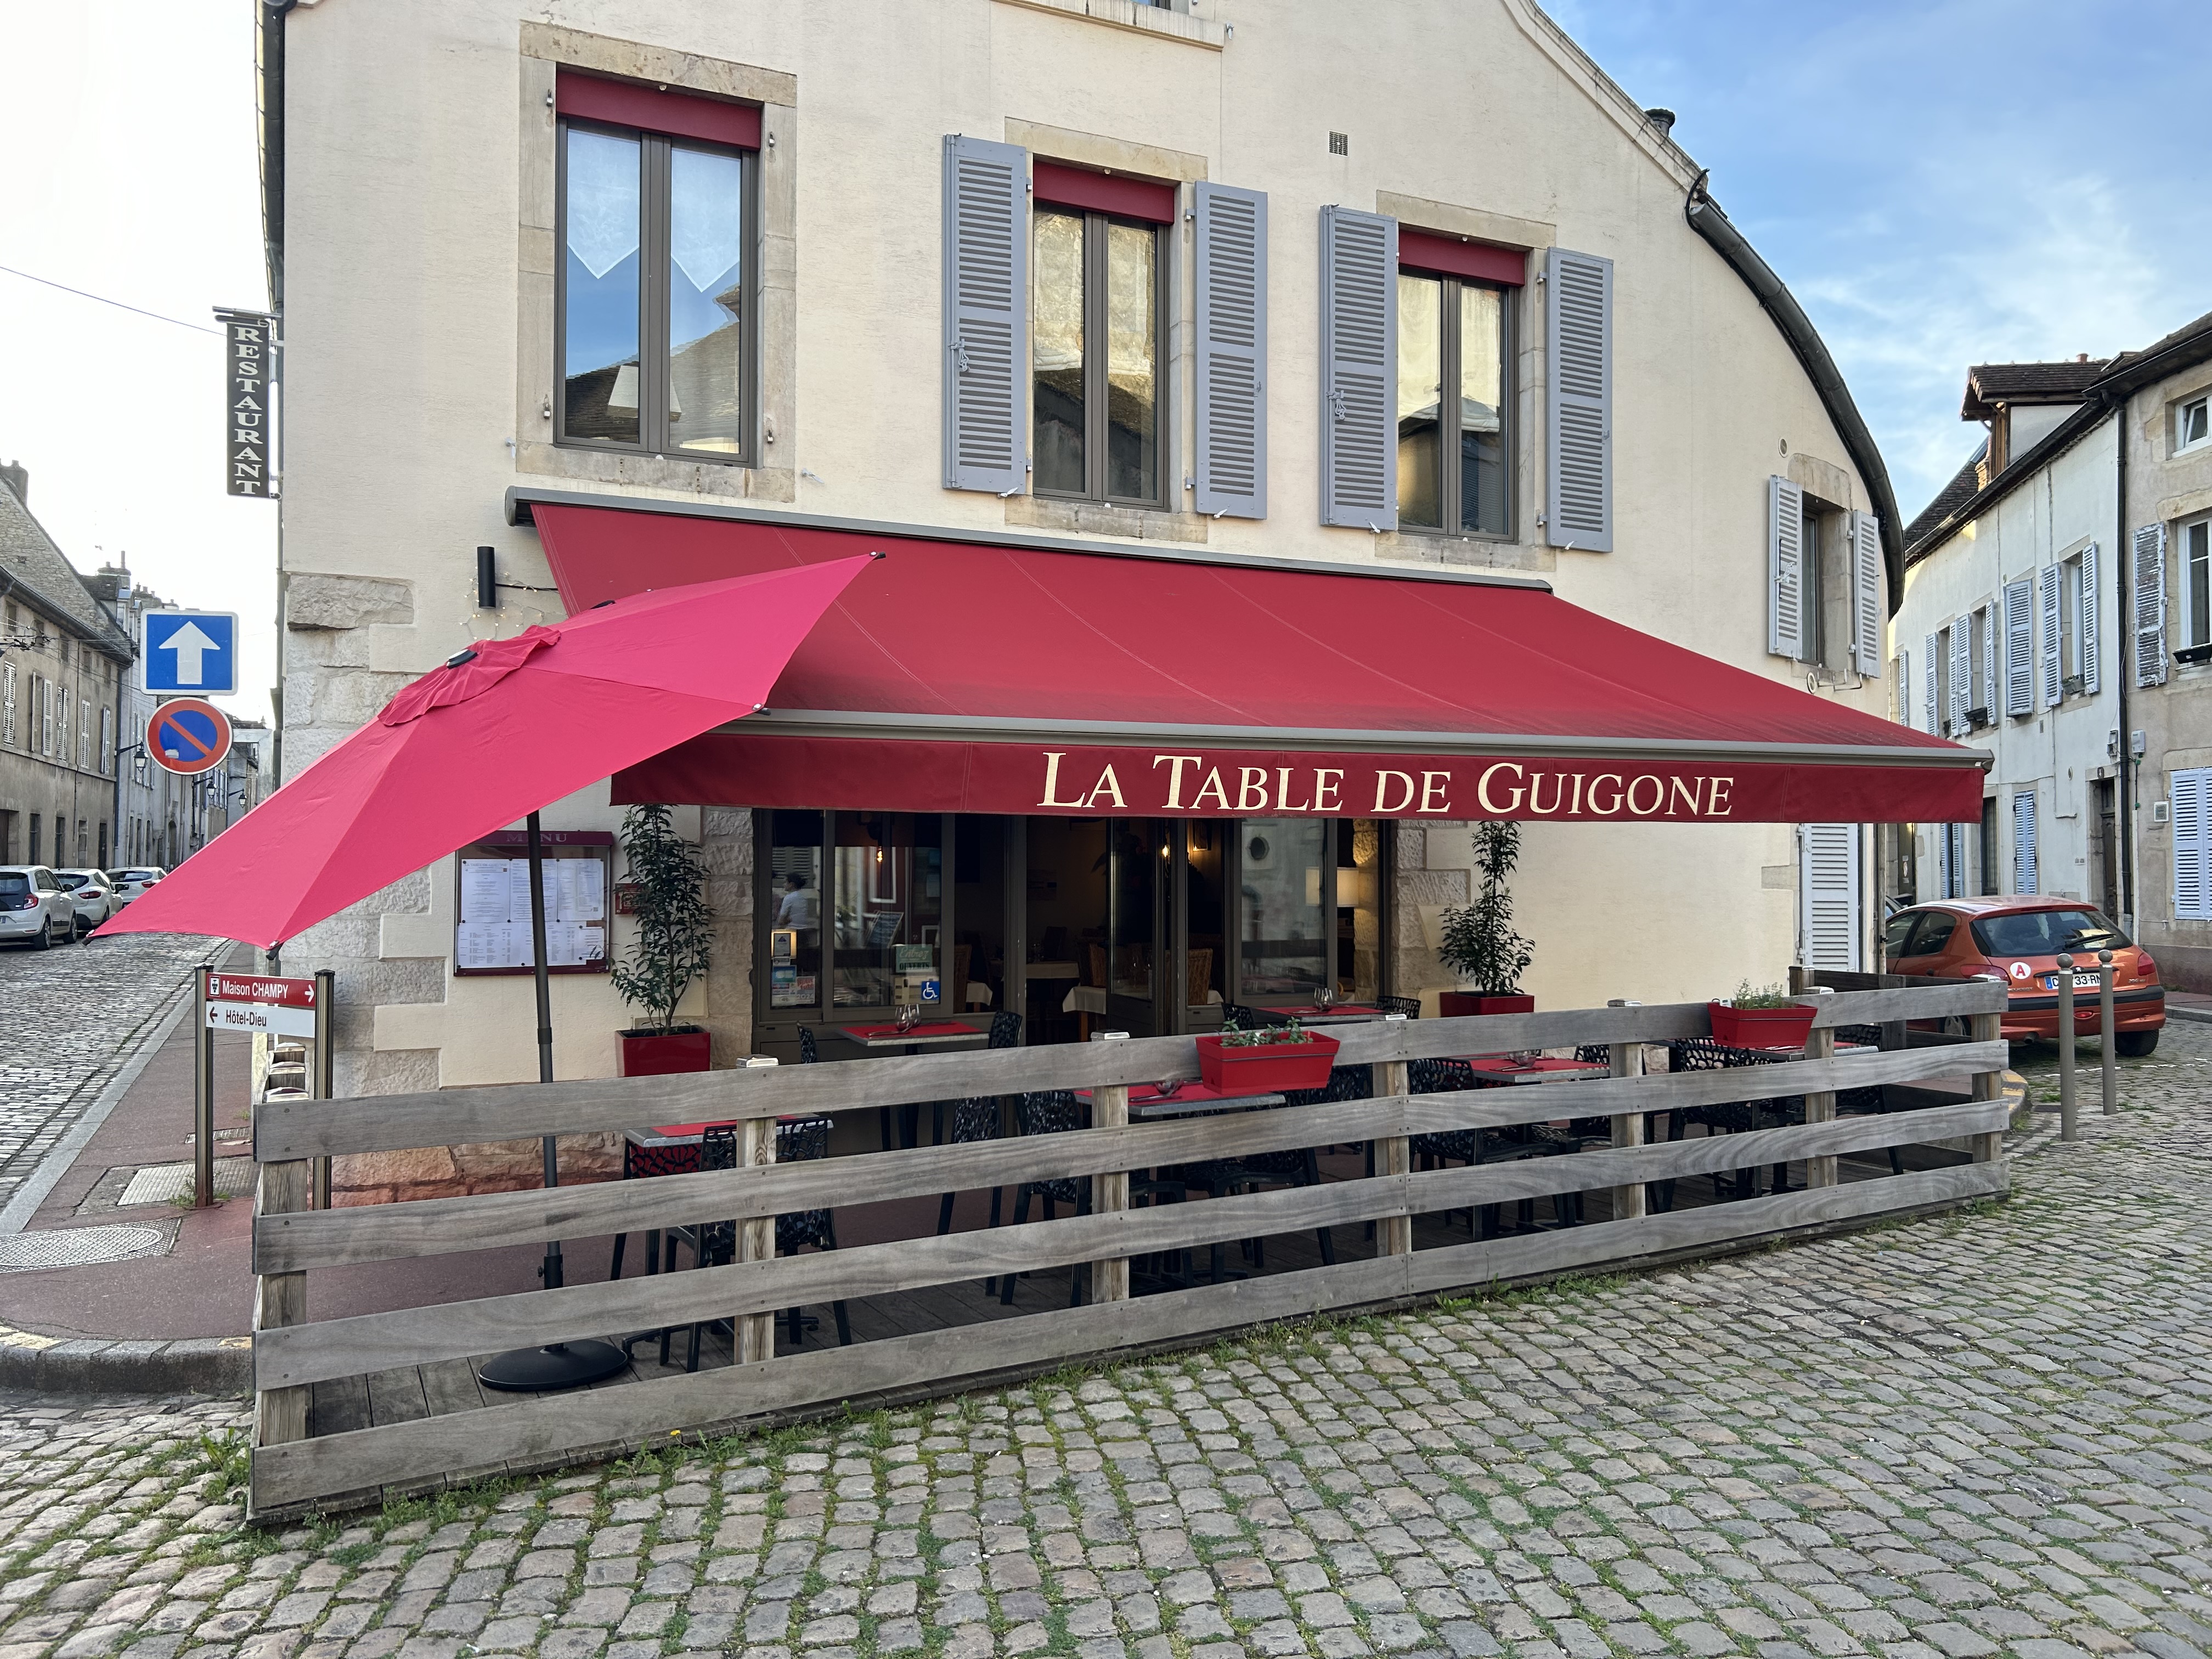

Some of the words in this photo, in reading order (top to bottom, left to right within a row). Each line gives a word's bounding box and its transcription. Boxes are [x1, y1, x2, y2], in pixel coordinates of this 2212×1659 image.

[234, 326, 263, 494] RESTAURANT
[1370, 770, 1451, 813] DE
[1477, 763, 1734, 816] GUIGONE
[506, 833, 567, 842] MNU
[2016, 965, 2025, 976] A
[222, 980, 250, 996] Maison
[252, 982, 289, 999] CHAMPY
[225, 1009, 267, 1027] Hôtel-Dieu
